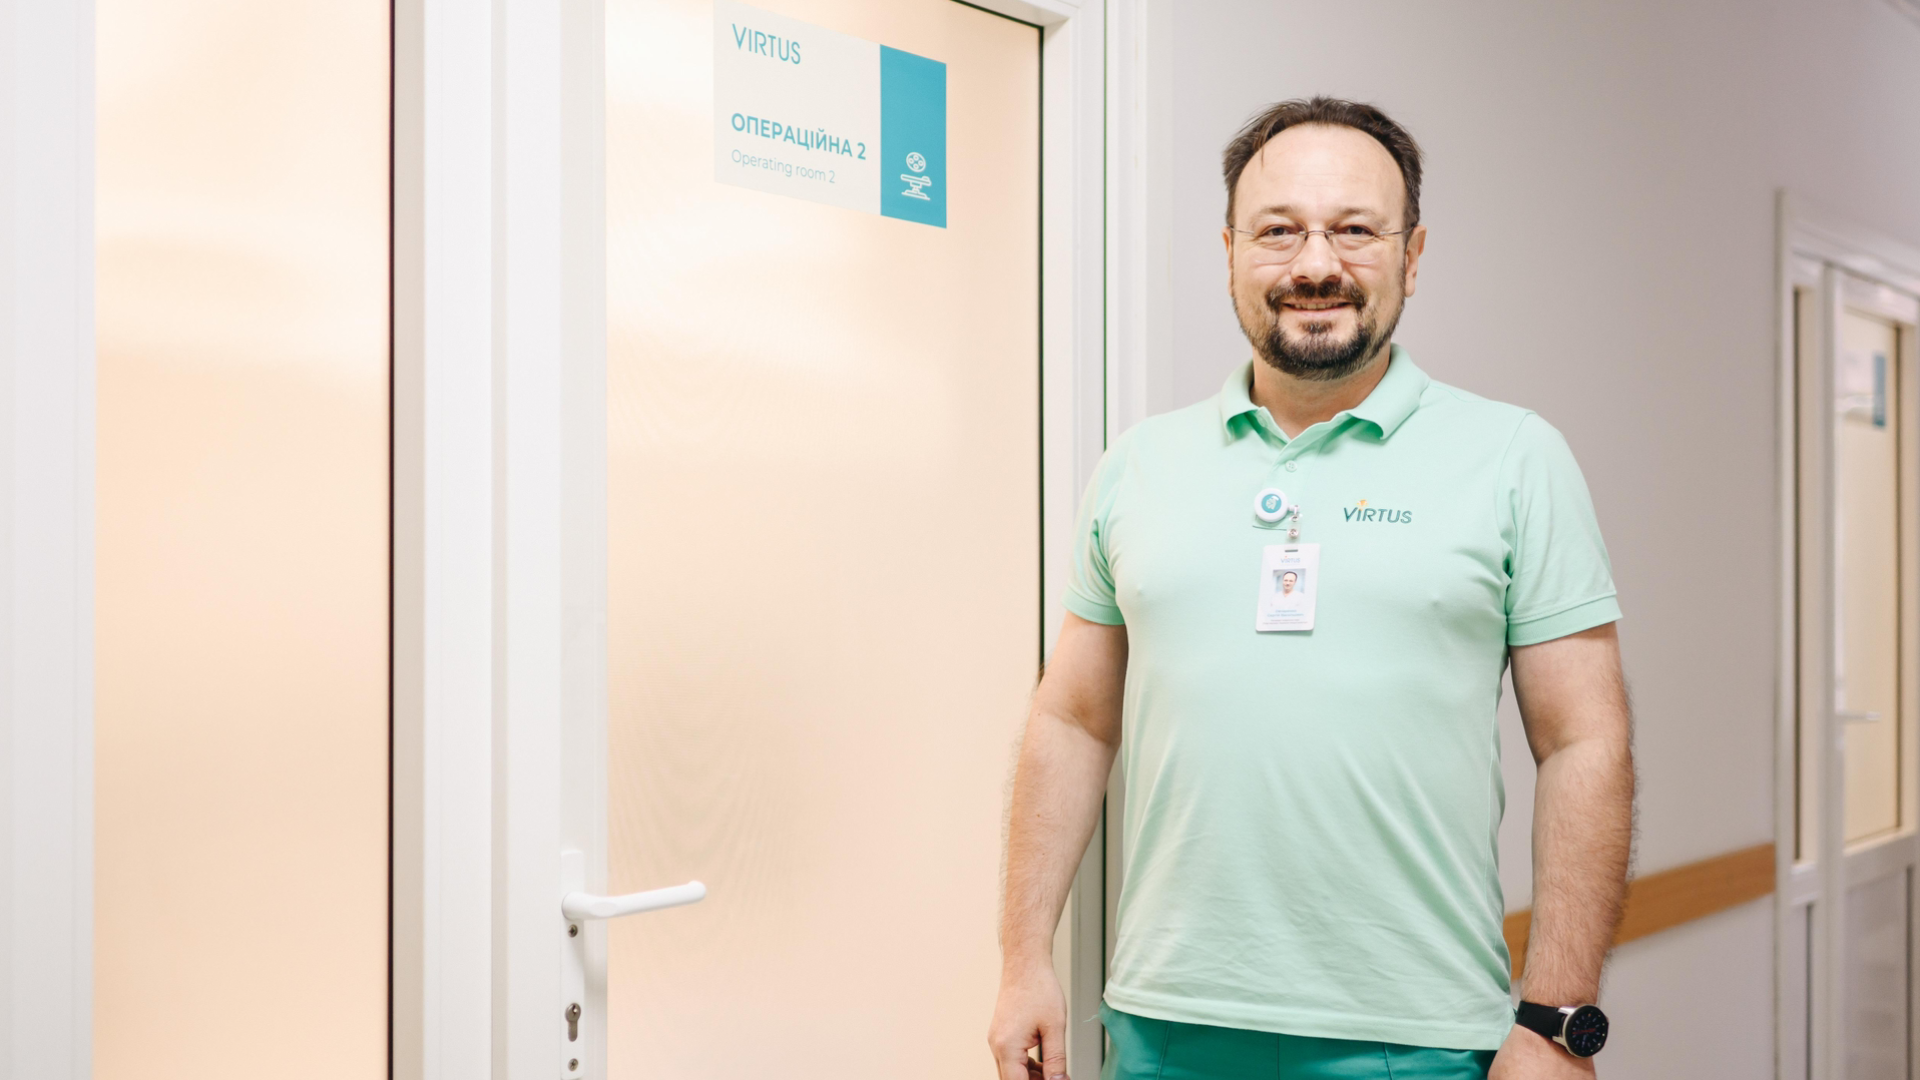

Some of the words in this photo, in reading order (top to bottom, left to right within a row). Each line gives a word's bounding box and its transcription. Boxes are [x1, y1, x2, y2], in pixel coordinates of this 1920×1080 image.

[732, 23, 801, 65] VIRTUS
[731, 112, 853, 158] ОПЕРАЦІЙНА
[857, 142, 867, 161] 2
[730, 149, 793, 177] Operating
[795, 165, 826, 182] room
[829, 170, 836, 184] 2
[1343, 504, 1413, 524] VIRTUS
